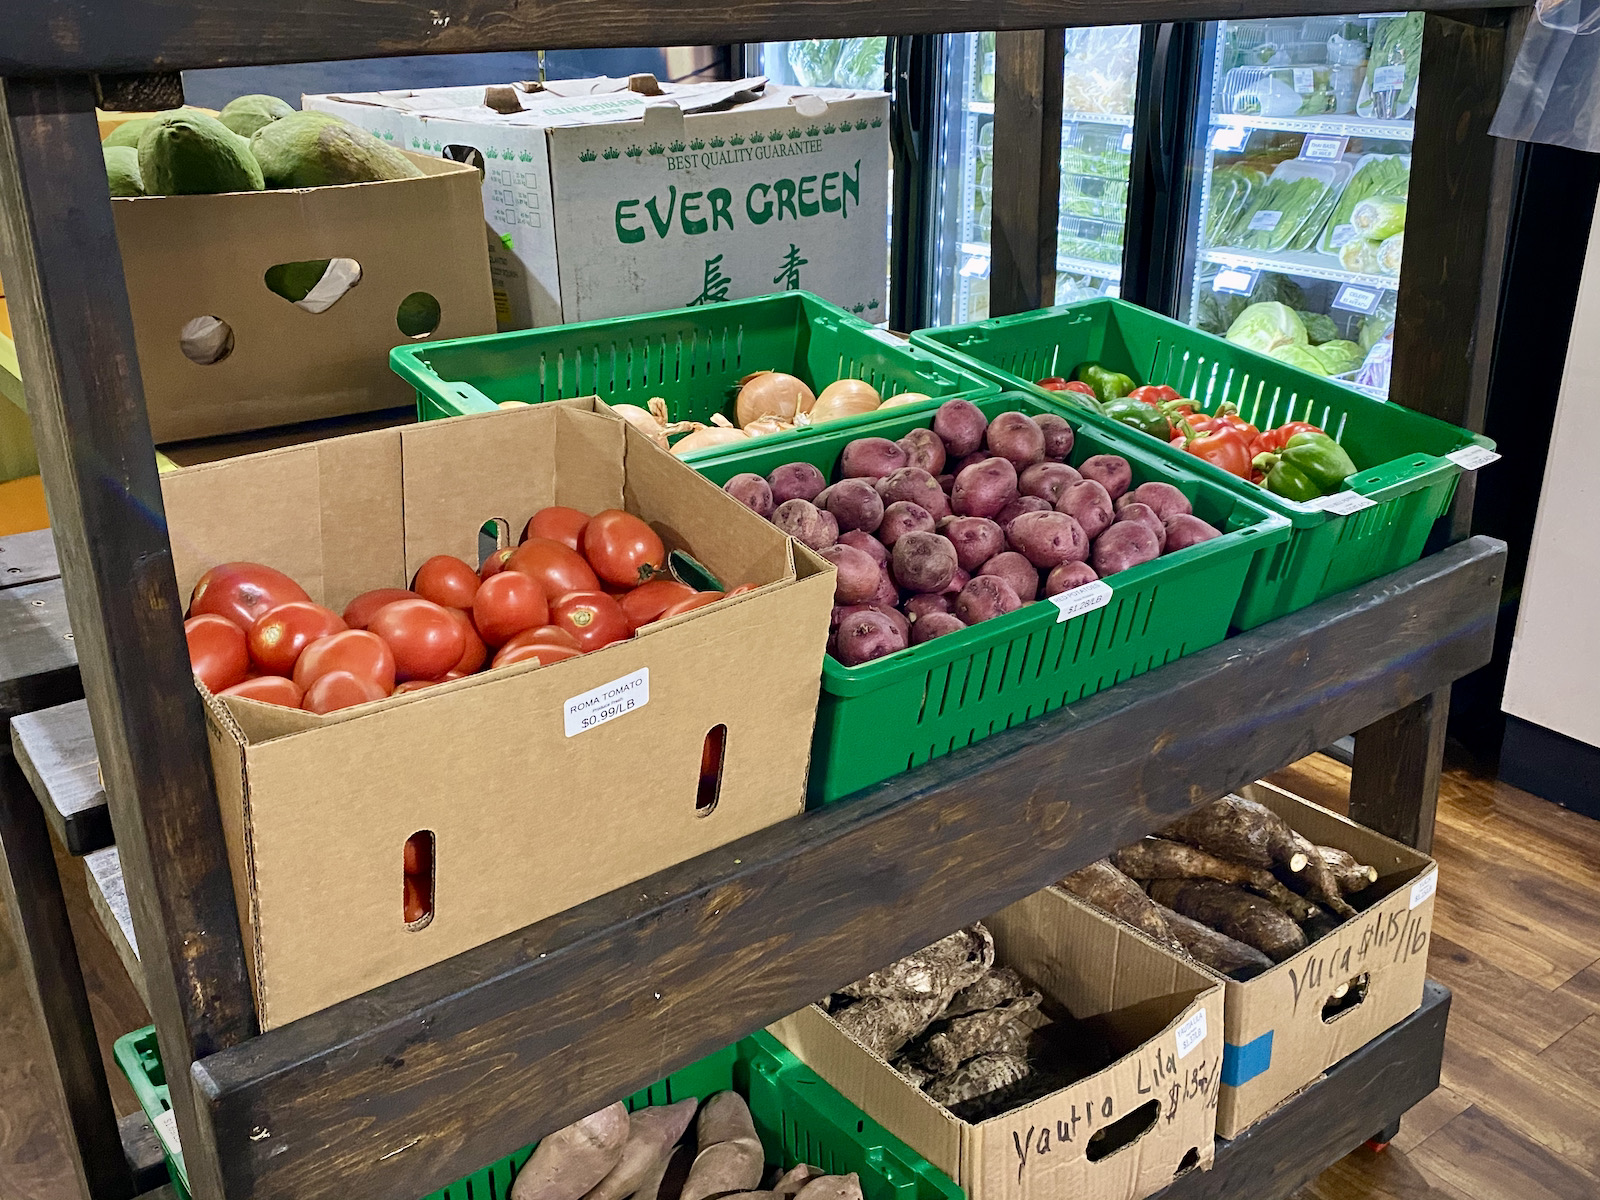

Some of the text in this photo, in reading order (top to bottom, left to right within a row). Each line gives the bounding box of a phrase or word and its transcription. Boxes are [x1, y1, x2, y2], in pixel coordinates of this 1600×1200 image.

[543, 98, 645, 115] REFRIGERATED
[667, 138, 824, 171] BEST QUALITY GUARANTEE
[615, 158, 862, 244] EVER GREEN
[570, 678, 643, 714] ROMA TOMATO
[581, 698, 635, 729] $0.99/LB
